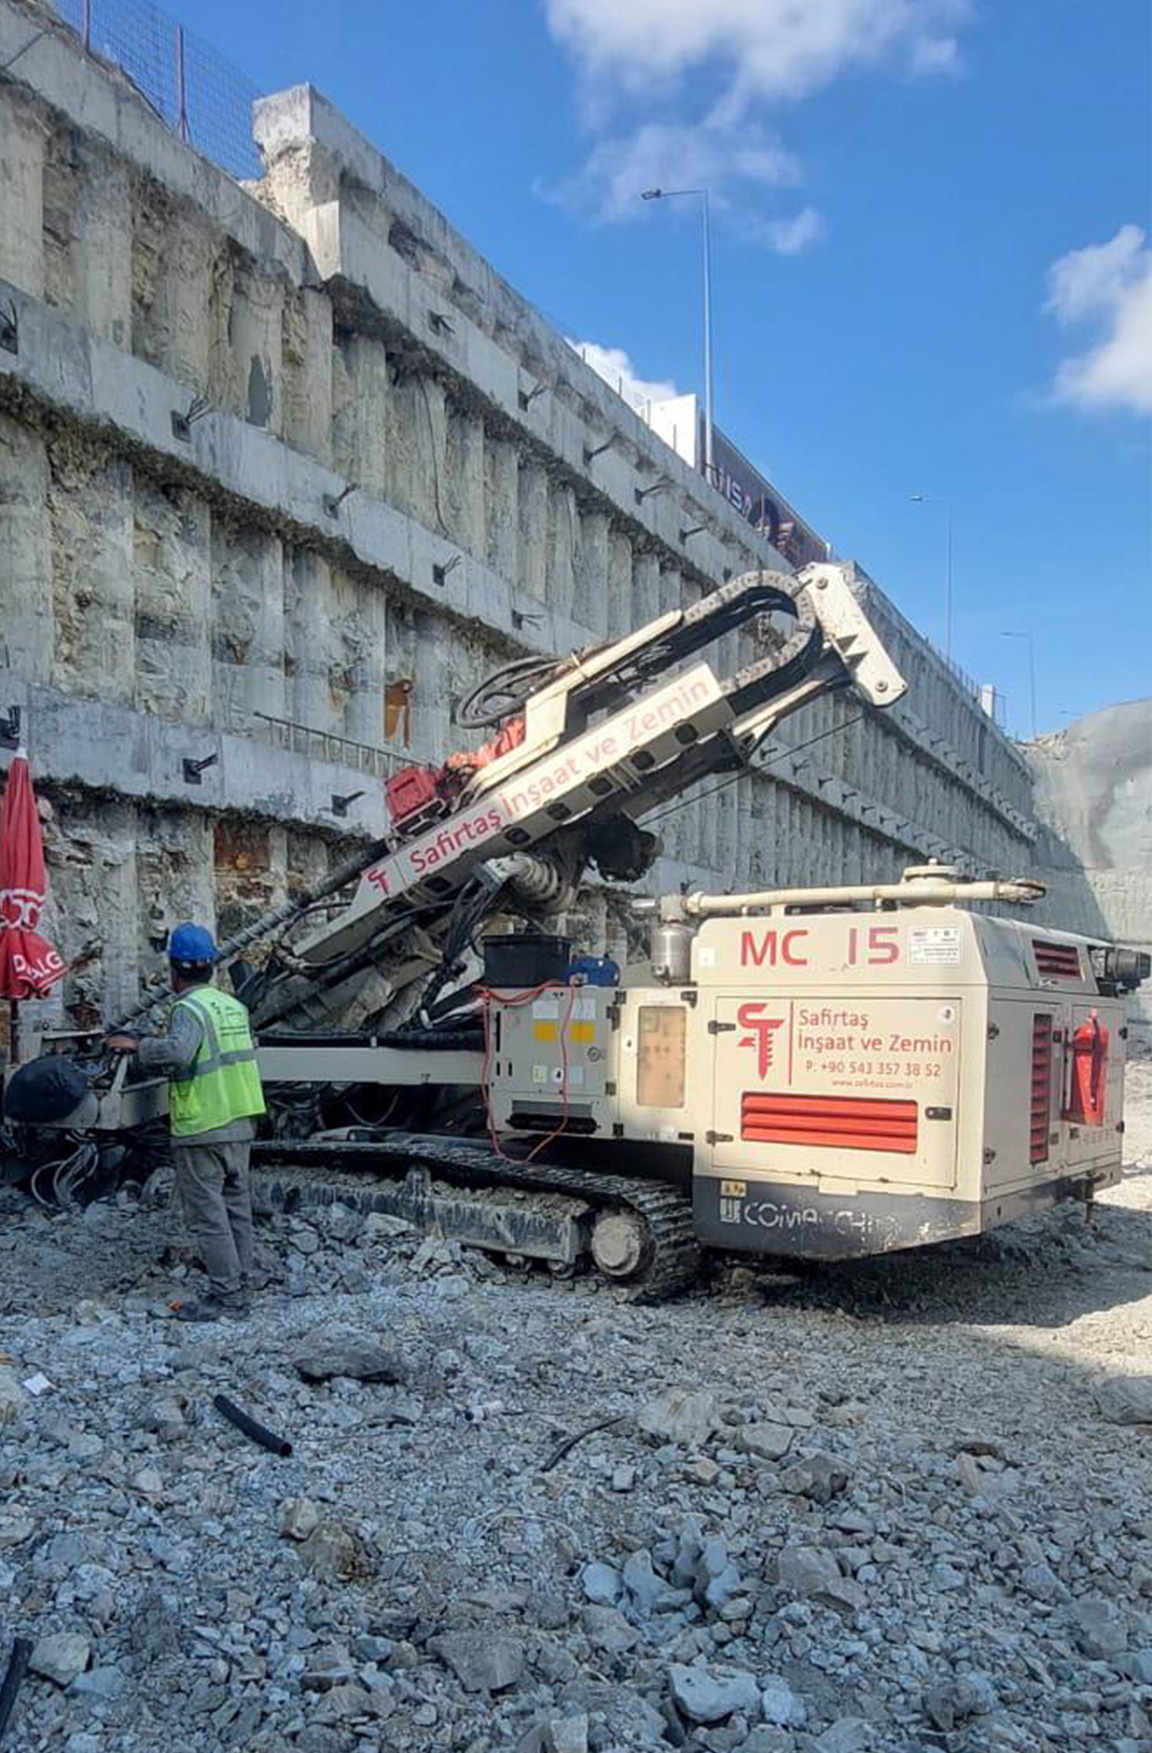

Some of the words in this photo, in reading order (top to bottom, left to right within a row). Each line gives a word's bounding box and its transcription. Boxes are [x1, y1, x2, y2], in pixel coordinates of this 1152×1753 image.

[409, 808, 503, 873] Safirtaş
[499, 758, 581, 818] İnşaat
[585, 738, 618, 764] ve
[624, 682, 709, 741] Zemin
[741, 930, 809, 966] MC
[848, 927, 900, 965] 15
[799, 1008, 869, 1030] Safirtaş
[798, 1029, 854, 1053] İnşaat
[860, 1037, 883, 1051] ve
[889, 1034, 952, 1053] Zemin
[821, 1061, 845, 1073] +90
[849, 1061, 873, 1075] 543
[876, 1062, 901, 1075] 357
[903, 1063, 921, 1077] 38
[924, 1063, 942, 1077] 52
